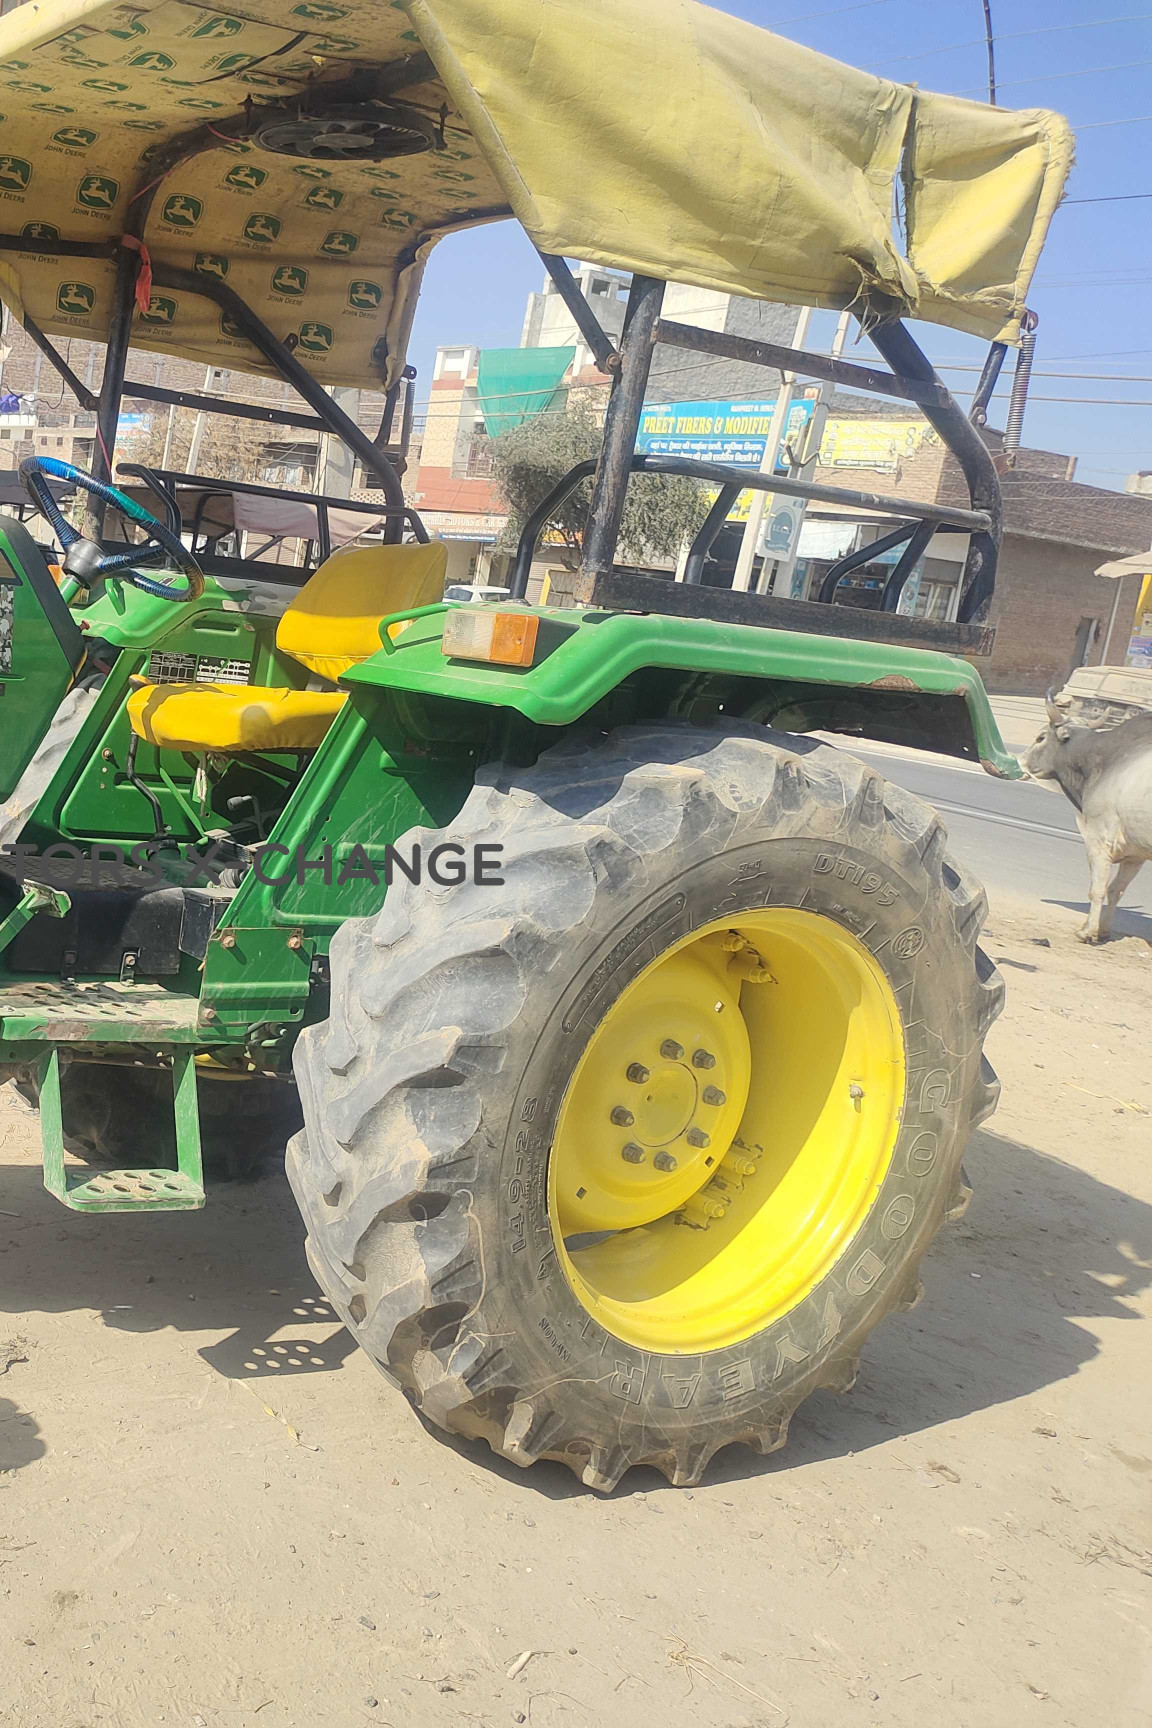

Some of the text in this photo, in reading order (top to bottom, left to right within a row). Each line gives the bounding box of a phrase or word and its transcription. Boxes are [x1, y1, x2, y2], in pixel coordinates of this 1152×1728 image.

[44, 144, 87, 159] JOHN DEERE
[3, 192, 26, 203] DEERE
[71, 207, 112, 221] JOHN DEERE
[18, 253, 59, 265] JOHN DEERE
[266, 295, 303, 306] JOHN DEERE
[50, 315, 90, 325] JOHN DEERE
[341, 309, 378, 320] JOHN DEERE
[310, 353, 328, 363] DEERE
[643, 416, 771, 435] PREET FIBERS & MODIFIE
[812, 852, 899, 906] DT195
[508, 1097, 538, 1254] 14.9-28
[538, 1317, 572, 1362] NYLON
